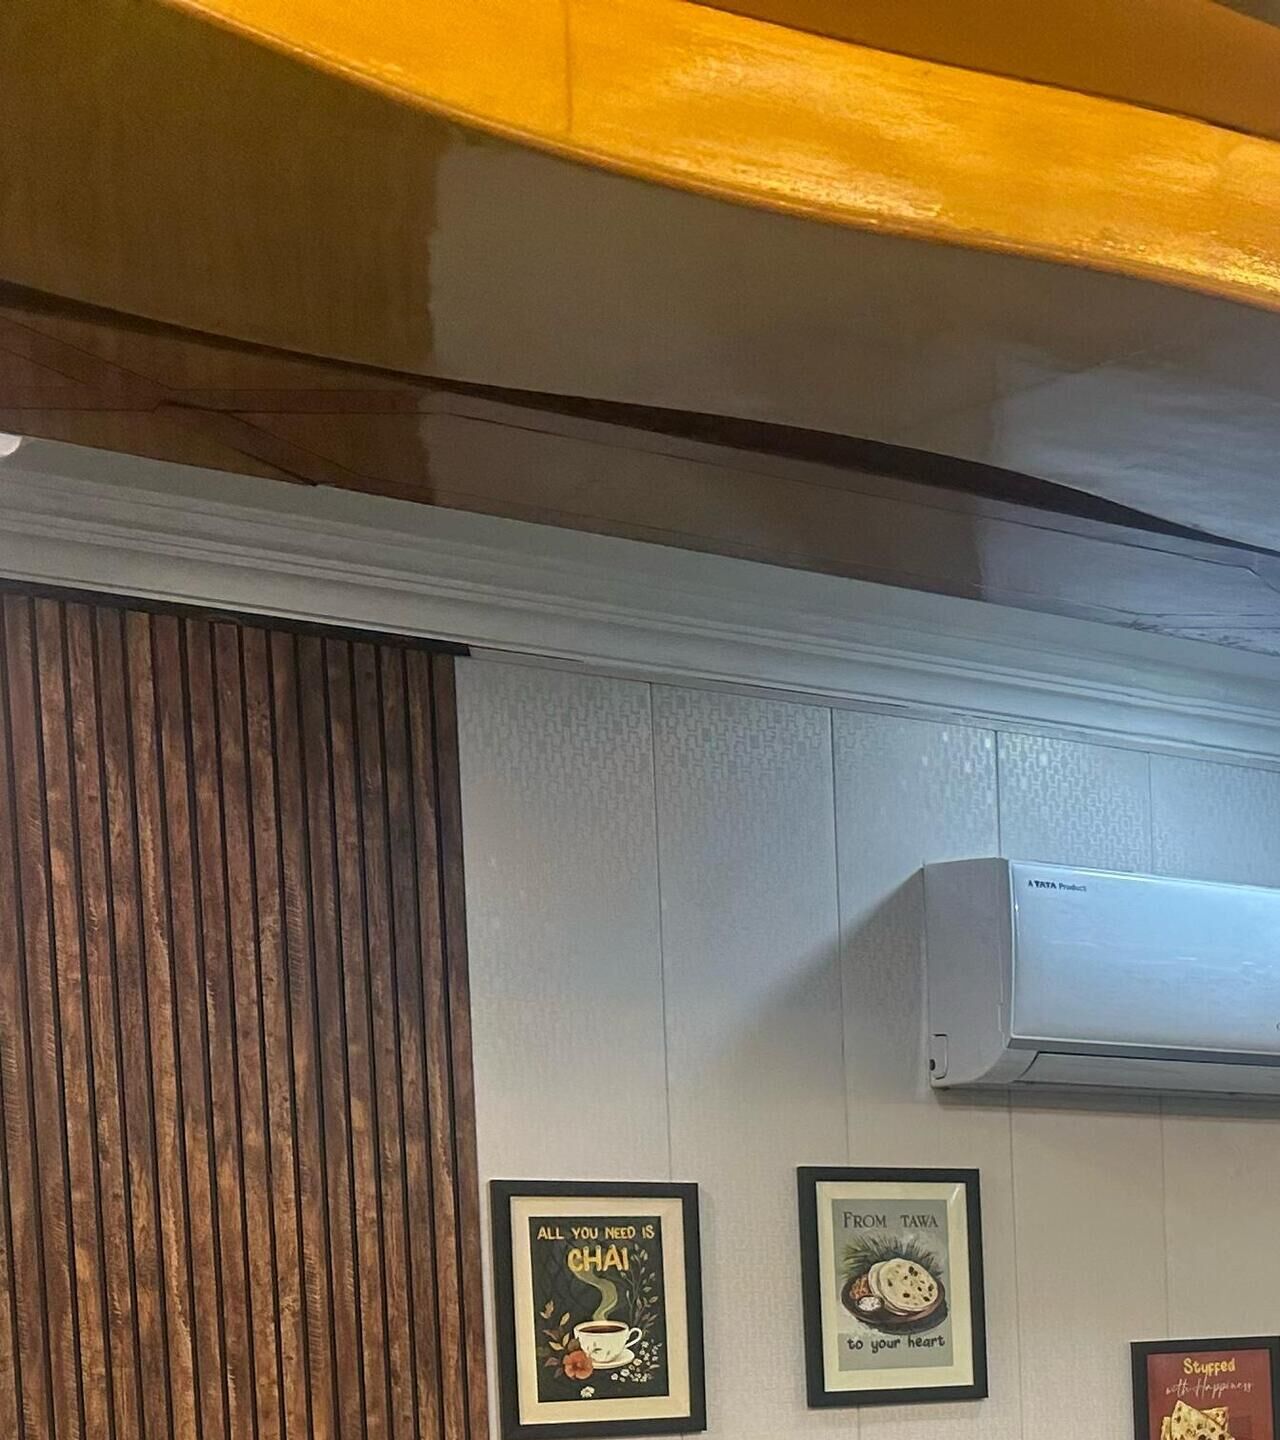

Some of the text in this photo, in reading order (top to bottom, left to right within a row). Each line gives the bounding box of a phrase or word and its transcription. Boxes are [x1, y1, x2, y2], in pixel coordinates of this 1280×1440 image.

[1034, 880, 1057, 889] TATA
[843, 1211, 939, 1229] FROM TAWA
[537, 1224, 656, 1240] ALL YOU NEED IS
[567, 1243, 630, 1272] CHAI
[847, 1335, 946, 1354] to your heart
[1183, 1357, 1236, 1376] Stuffed
